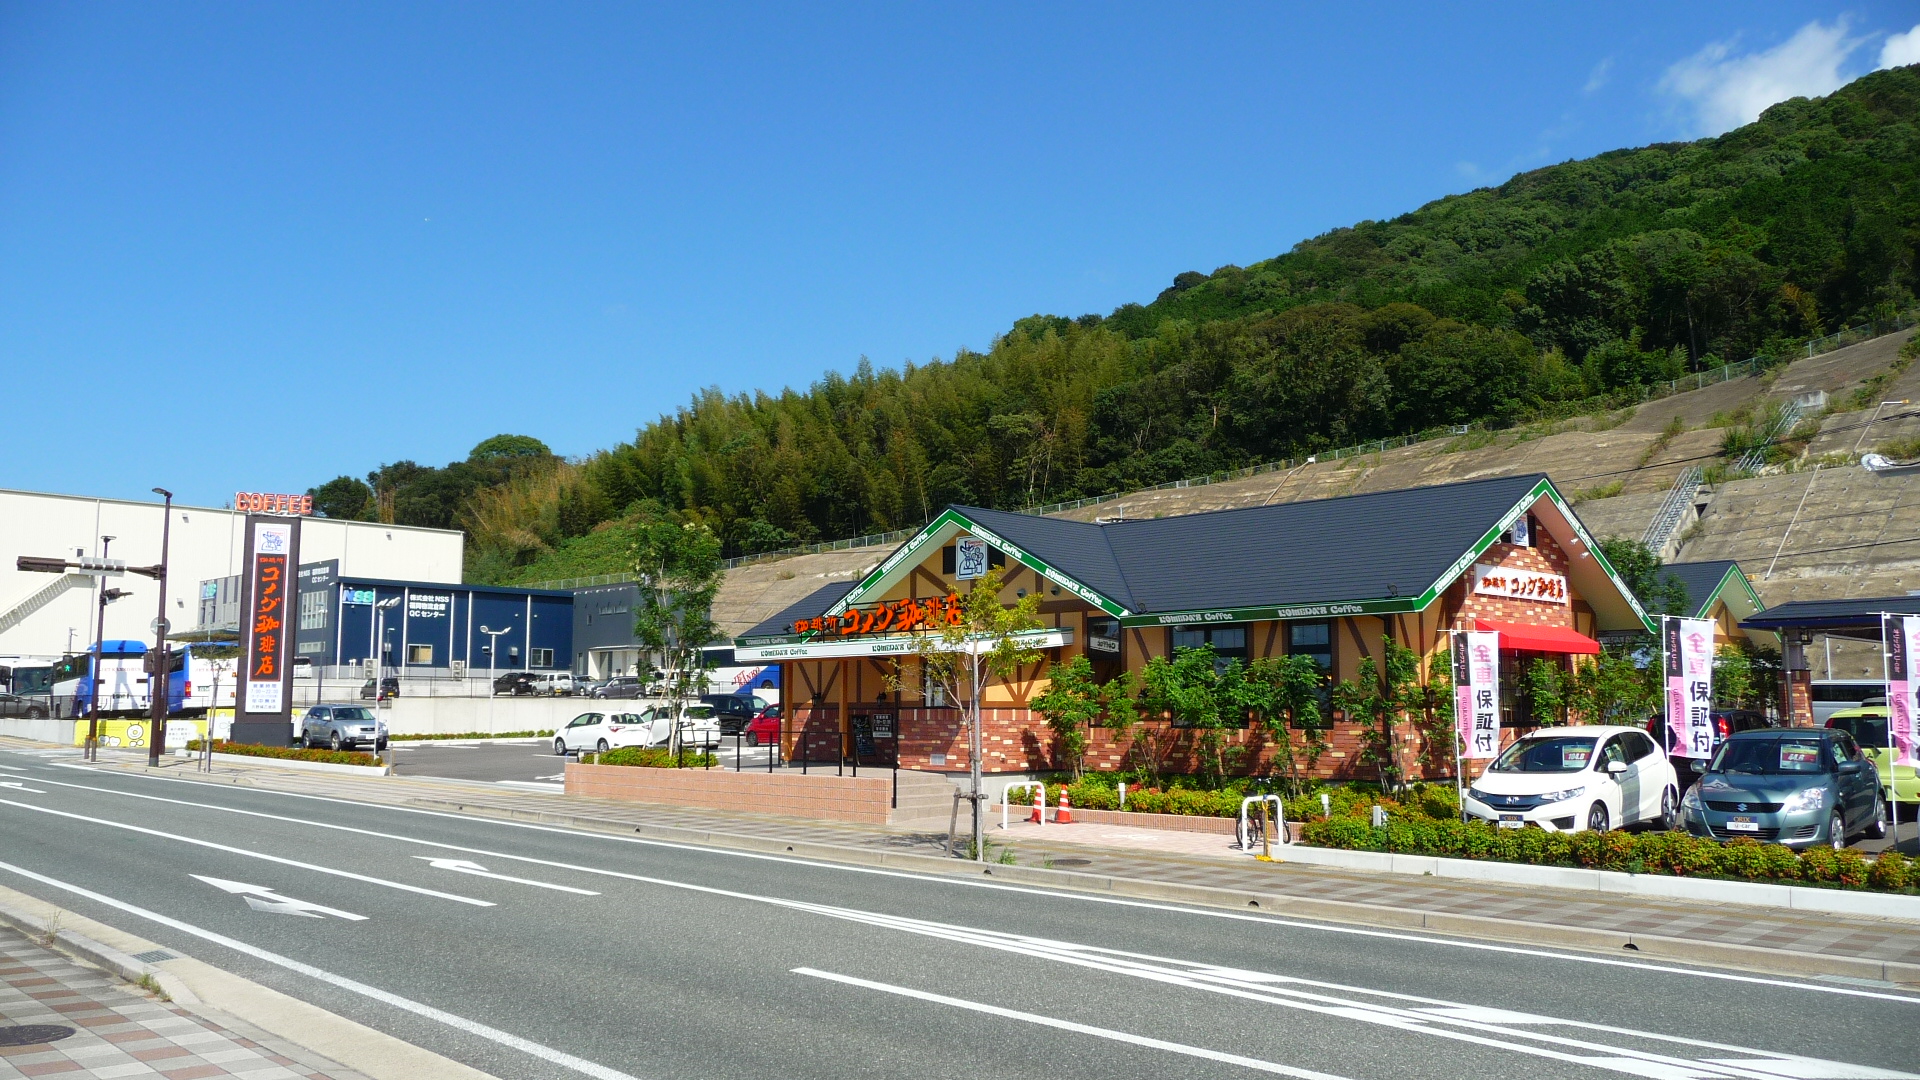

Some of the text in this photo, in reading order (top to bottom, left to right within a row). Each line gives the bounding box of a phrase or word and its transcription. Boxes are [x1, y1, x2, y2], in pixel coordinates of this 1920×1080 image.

[236, 492, 312, 514] COFFEE
[342, 589, 374, 602] NSS
[1080, 588, 1103, 605] Coffee
[794, 592, 964, 635] 珈琲所 コメダ珈琲店
[1159, 612, 1233, 624] KOMEDA'S Coffee
[1278, 604, 1363, 617] KOMEDA'S Coffee
[254, 566, 282, 676] コメダ珈琲店
[789, 648, 808, 656] Coffee
[1473, 644, 1494, 752] 全車保証付
[1686, 632, 1710, 753] 全車保証付
